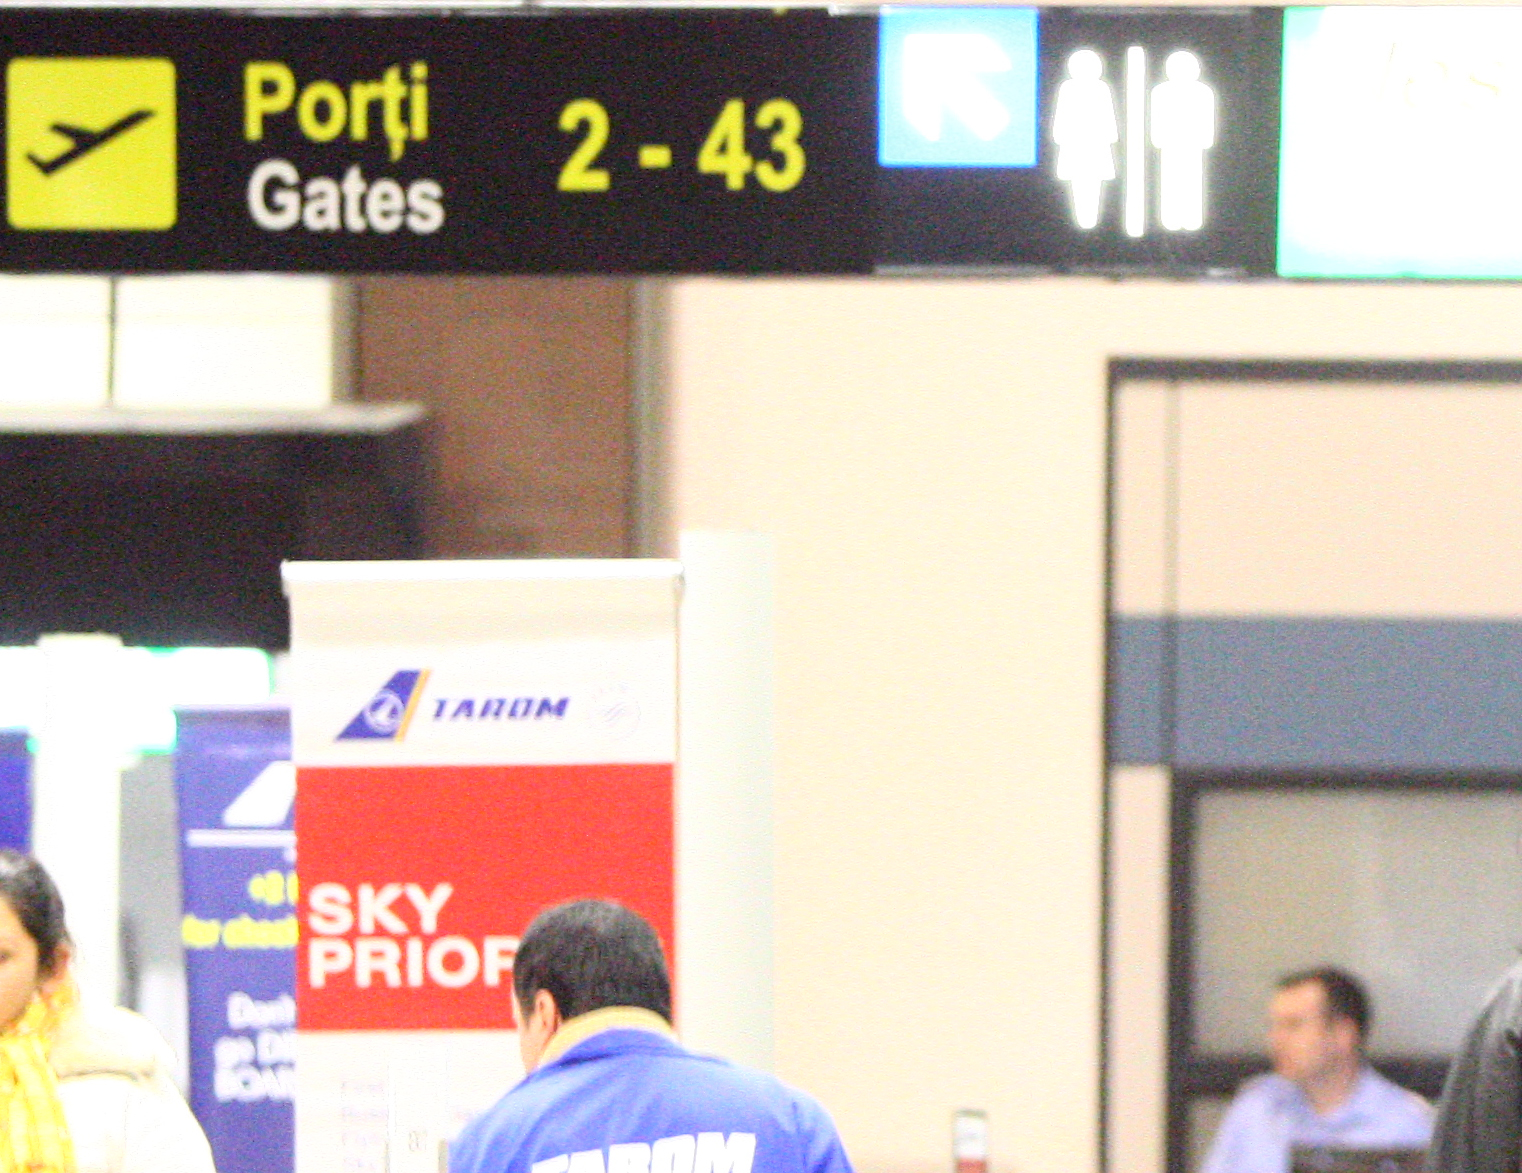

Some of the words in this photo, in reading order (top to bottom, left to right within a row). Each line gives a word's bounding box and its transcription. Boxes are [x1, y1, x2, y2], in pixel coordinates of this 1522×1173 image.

[557, 97, 611, 192] 2
[637, 143, 673, 170] -
[697, 97, 806, 192] 43
[247, 158, 445, 234] Gates
[433, 697, 570, 720] TAROM
[308, 882, 454, 935] SKY
